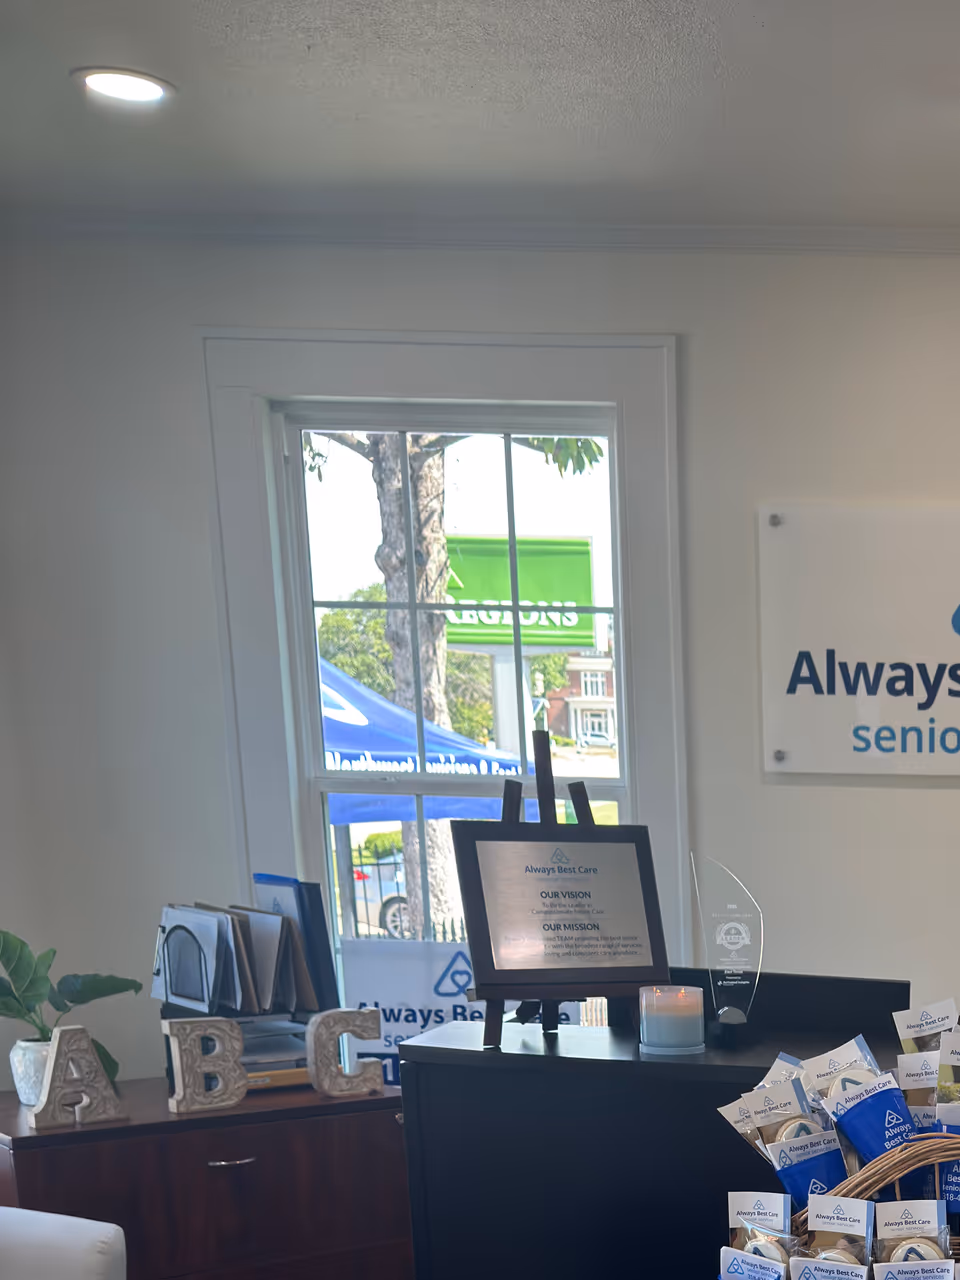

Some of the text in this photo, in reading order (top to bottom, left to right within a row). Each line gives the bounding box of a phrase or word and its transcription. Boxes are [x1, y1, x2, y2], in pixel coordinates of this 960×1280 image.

[525, 865, 598, 876] Always Best Care
[540, 891, 591, 899] OUR VISION
[543, 923, 600, 931] OUR MISSION
[906, 1021, 924, 1030] Always
[906, 1070, 920, 1078] Always
[845, 1080, 891, 1104] Always Best Care
[885, 1124, 911, 1138] Always
[789, 1137, 836, 1153] Always Best Care
[884, 1136, 903, 1149] Best
[736, 1210, 755, 1218] Always
[816, 1214, 835, 1222] Always
[814, 1266, 863, 1280] Always Best Care
